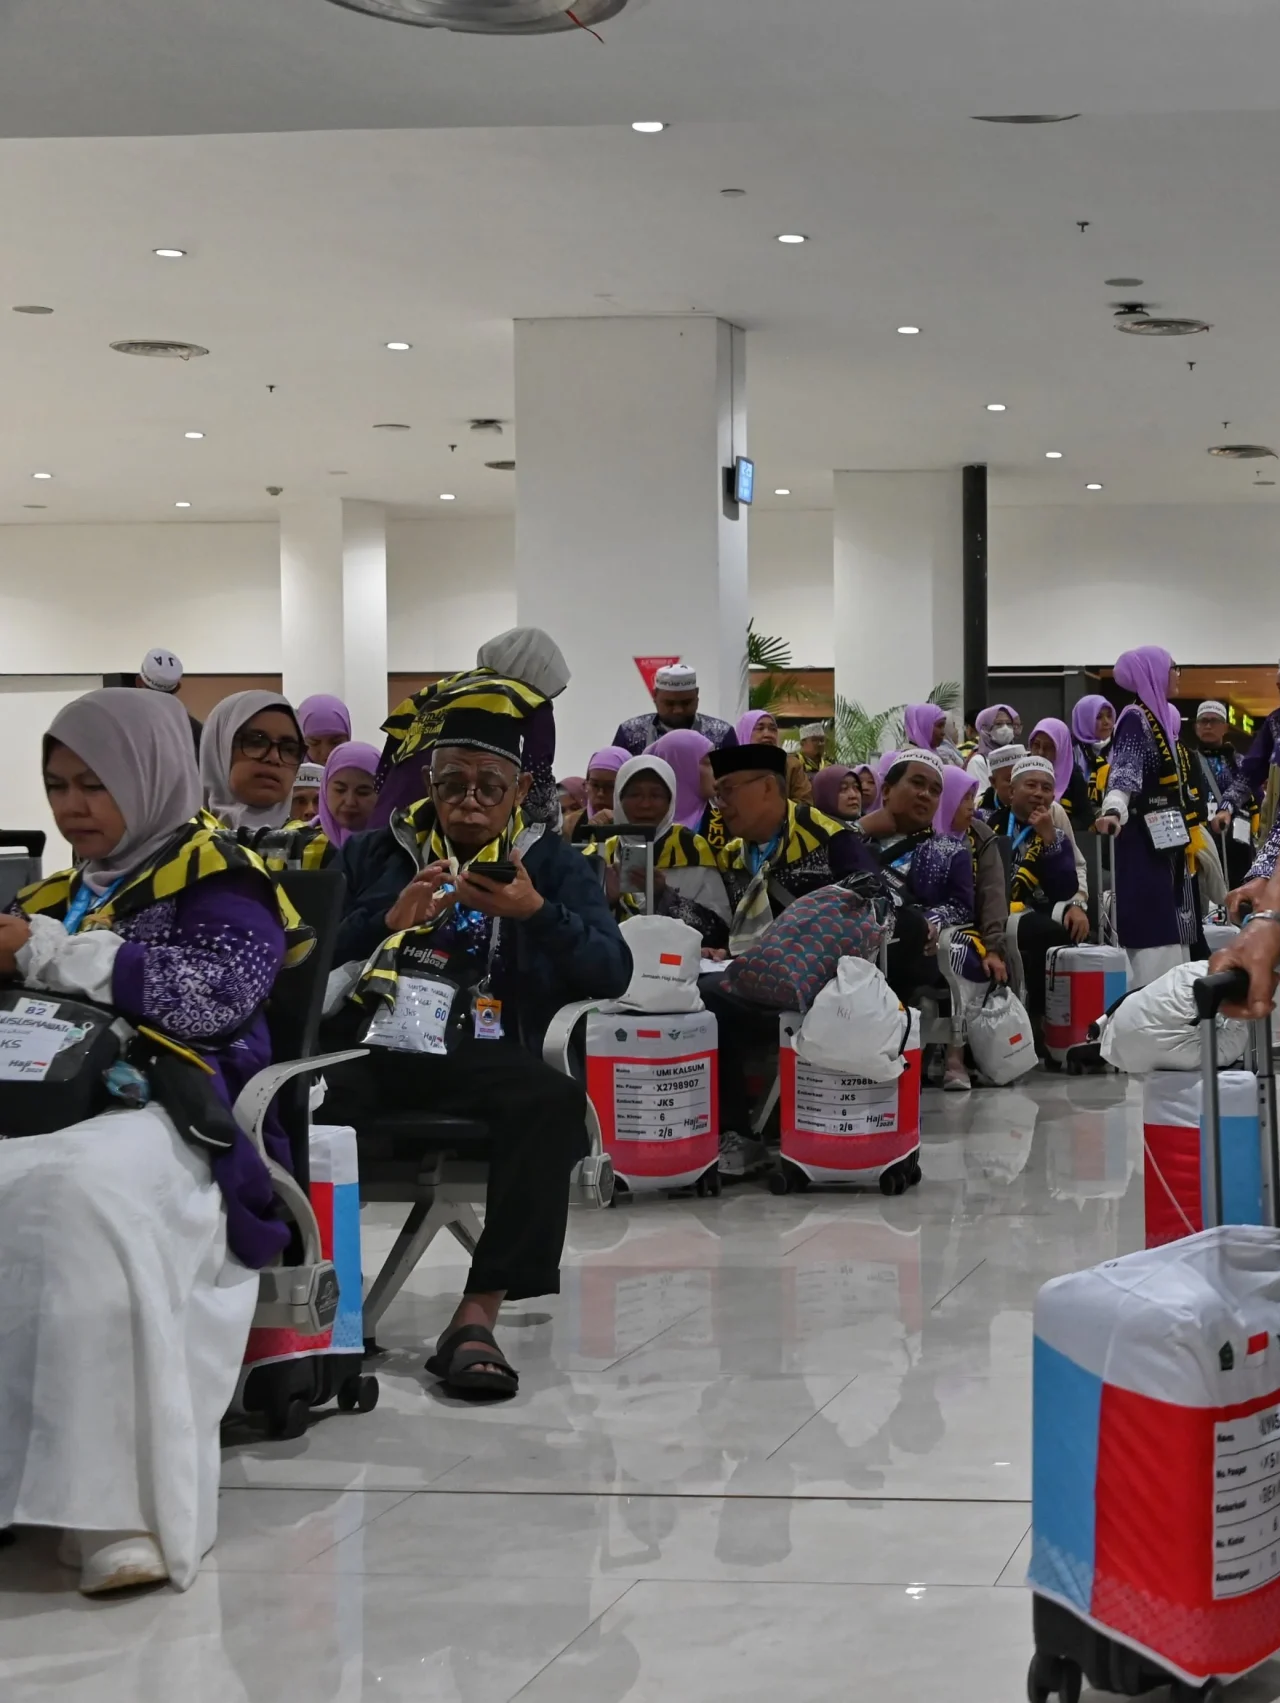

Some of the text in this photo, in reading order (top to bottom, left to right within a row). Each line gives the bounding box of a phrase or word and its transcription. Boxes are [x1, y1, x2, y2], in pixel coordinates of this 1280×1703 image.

[25, 1006, 47, 1016] 82
[434, 1007, 446, 1021] 60
[656, 1069, 672, 1077] UMI
[673, 1063, 704, 1074] KALSUM
[656, 1080, 699, 1092] X2798907
[657, 1099, 674, 1107] JKS
[660, 1113, 665, 1121] 6
[839, 1123, 853, 1132] 2/8
[658, 1128, 673, 1138] 2/8
